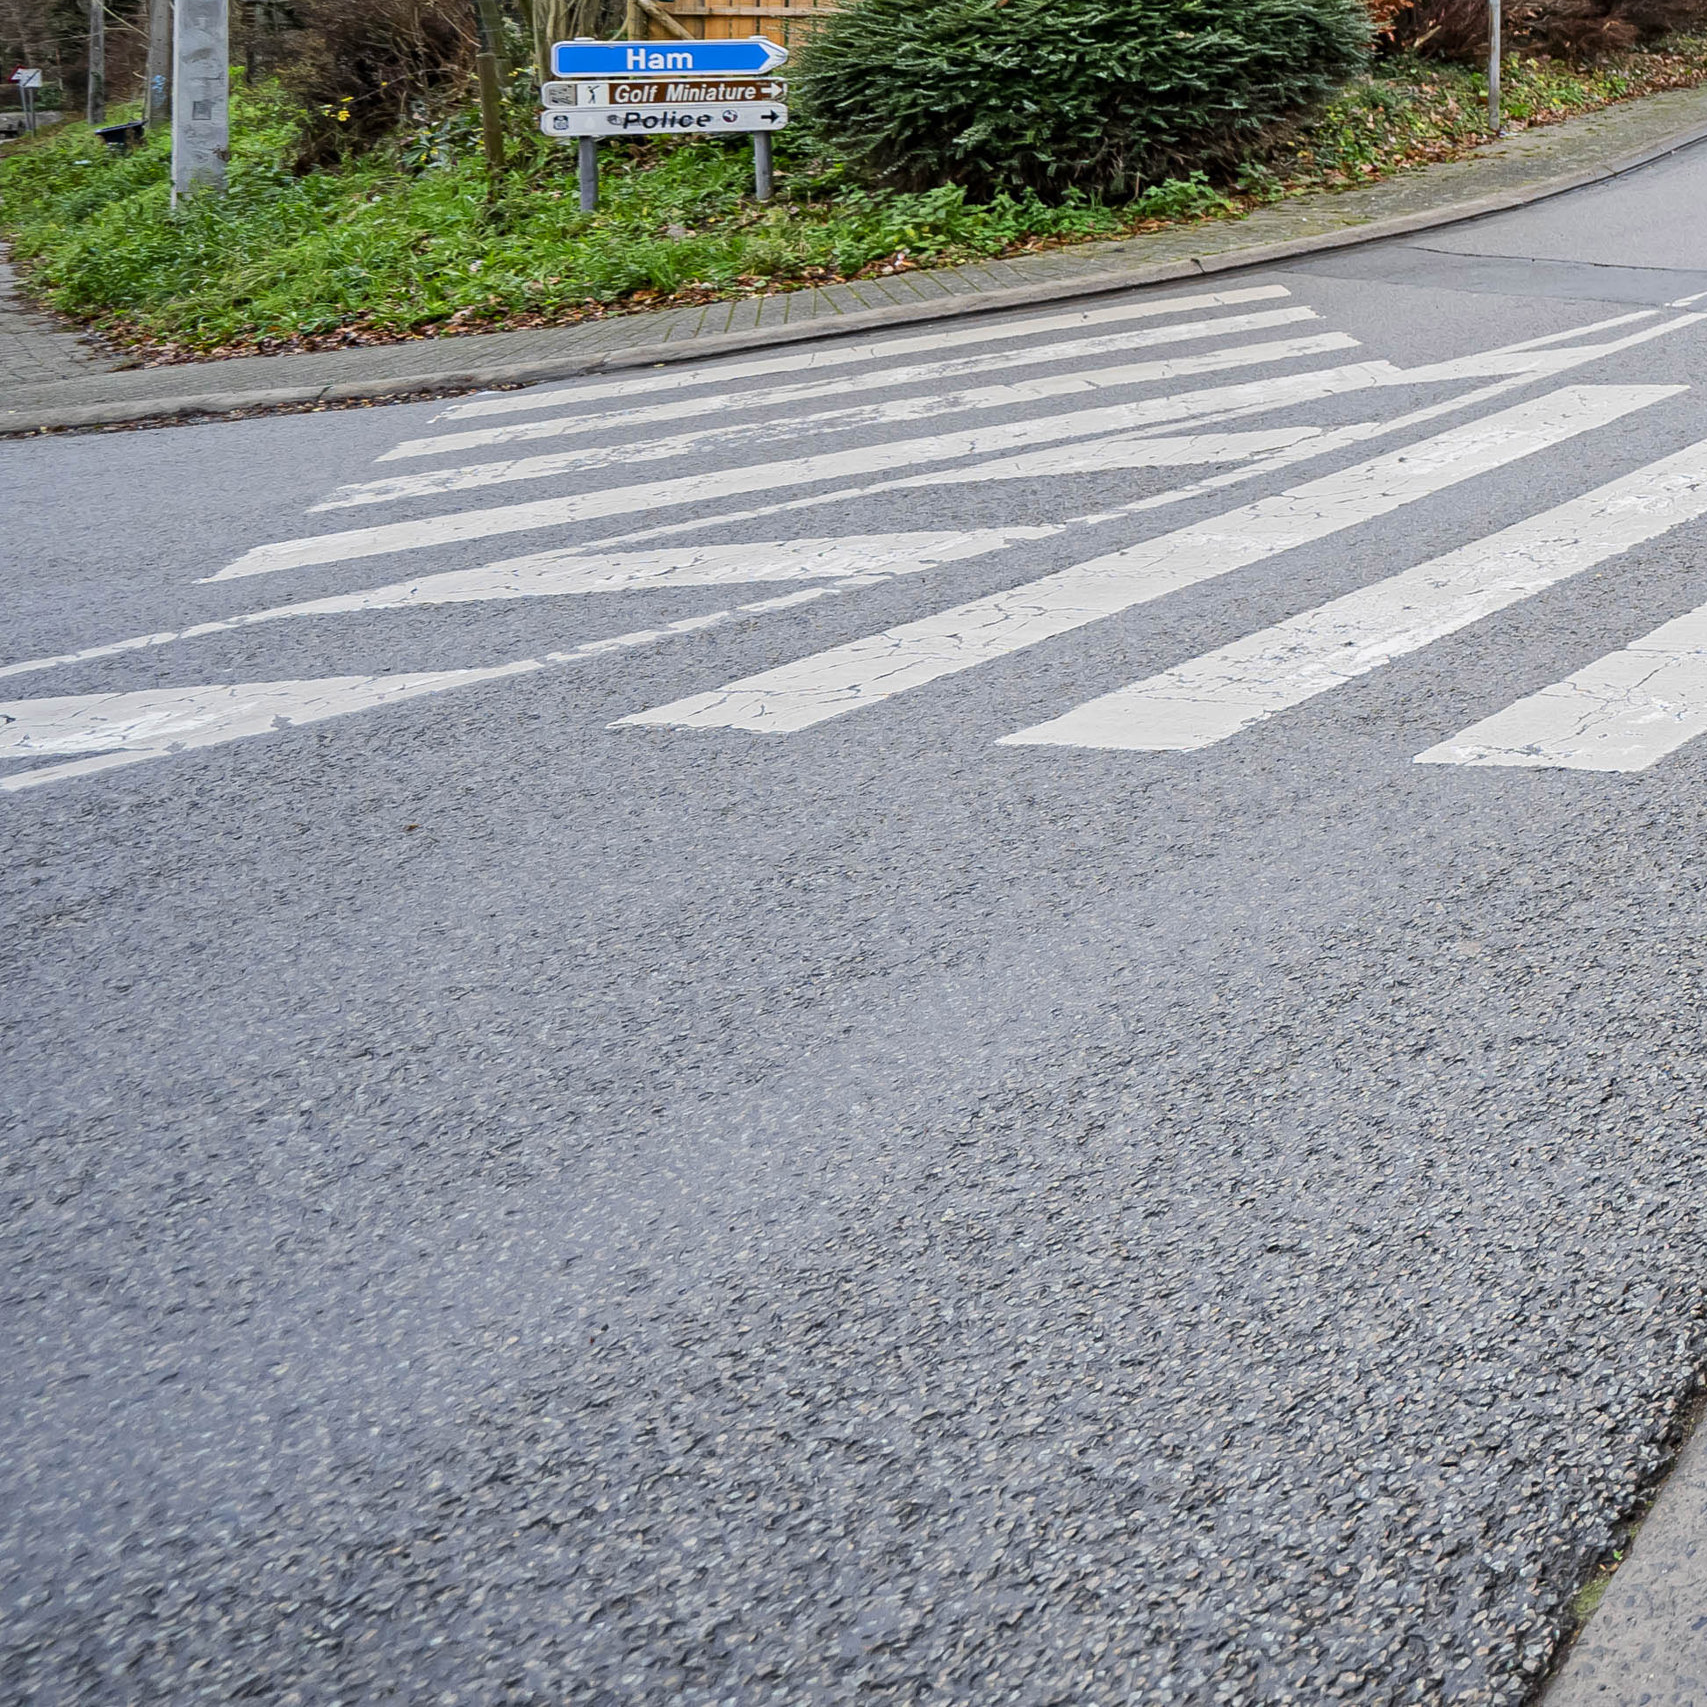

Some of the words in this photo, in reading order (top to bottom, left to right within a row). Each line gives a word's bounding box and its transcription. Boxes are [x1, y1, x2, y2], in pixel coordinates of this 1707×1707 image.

[627, 48, 693, 70] Ham
[615, 84, 658, 103] Golf
[665, 83, 757, 102] Miniature
[622, 110, 713, 129] Police
